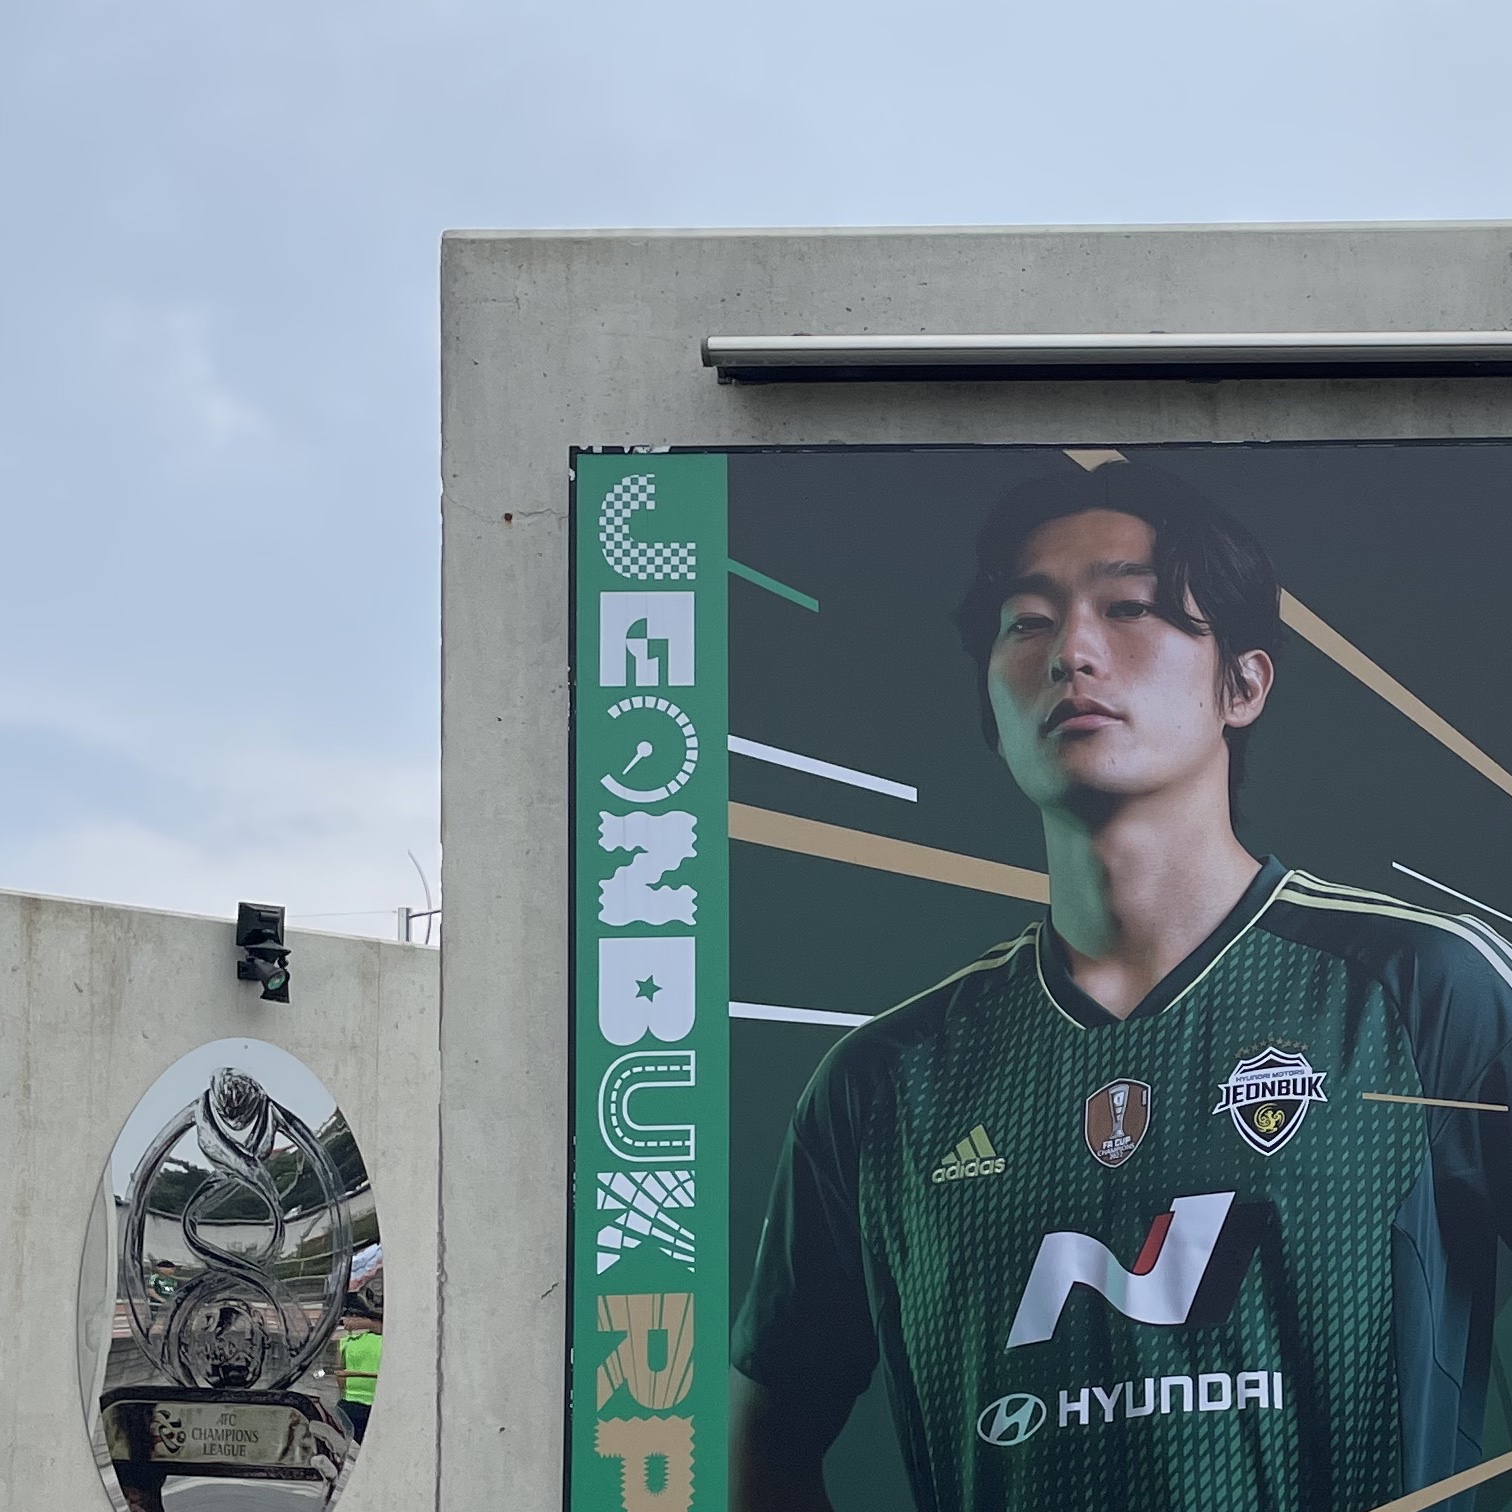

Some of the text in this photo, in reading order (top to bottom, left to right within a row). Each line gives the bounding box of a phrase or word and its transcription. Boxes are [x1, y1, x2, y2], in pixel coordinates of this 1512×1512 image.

[597, 473, 698, 1274] JEONBUK
[1271, 1068, 1305, 1078] MOTORS
[1217, 1075, 1323, 1110] JEONBUK
[1114, 1135, 1131, 1147] CUP
[931, 1157, 1007, 1184] adidas
[1058, 1370, 1284, 1428] HYUNDAI
[191, 1427, 259, 1443] CHAMPIONS
[203, 1443, 247, 1457] LEAGUE
